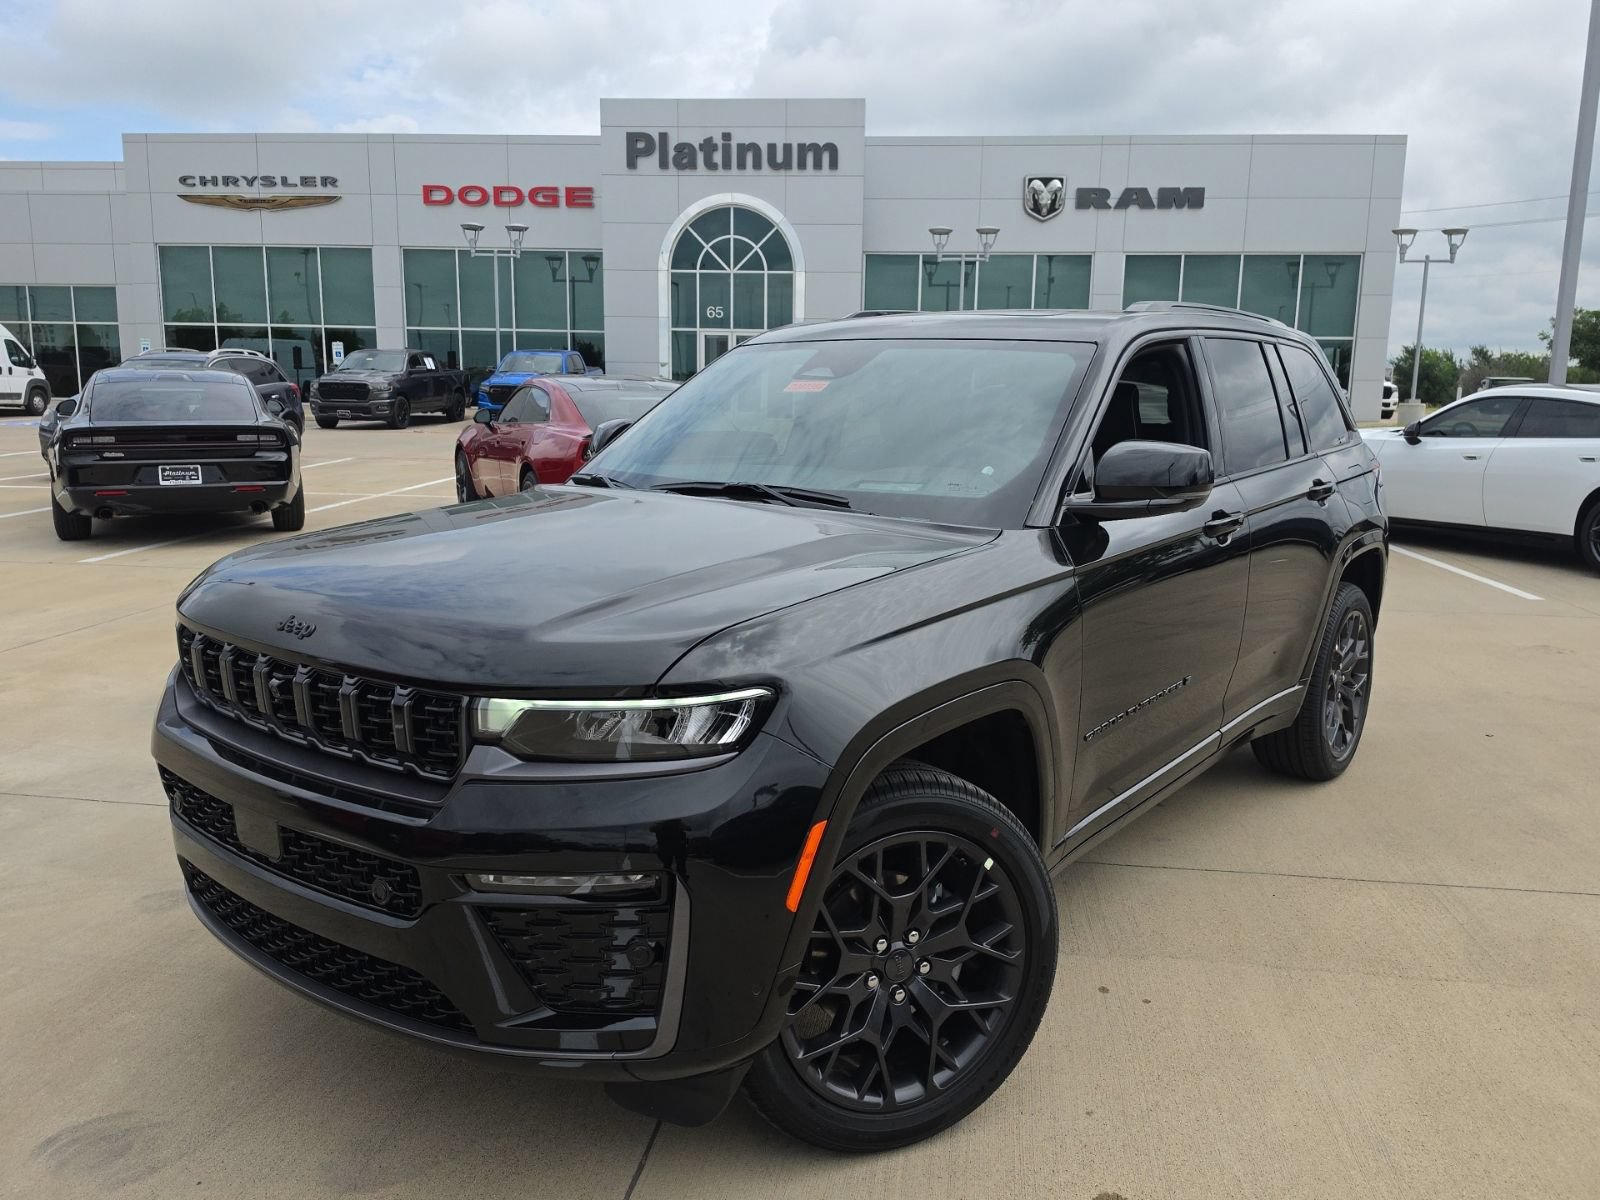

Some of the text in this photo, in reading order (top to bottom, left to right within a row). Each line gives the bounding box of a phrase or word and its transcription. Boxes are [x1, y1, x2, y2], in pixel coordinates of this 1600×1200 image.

[625, 131, 839, 171] Platinum
[178, 175, 339, 188] CHRYSLER
[422, 184, 595, 209] DODGE
[1075, 186, 1206, 210] RAM
[706, 305, 725, 319] 65
[277, 614, 317, 640] Jeep
